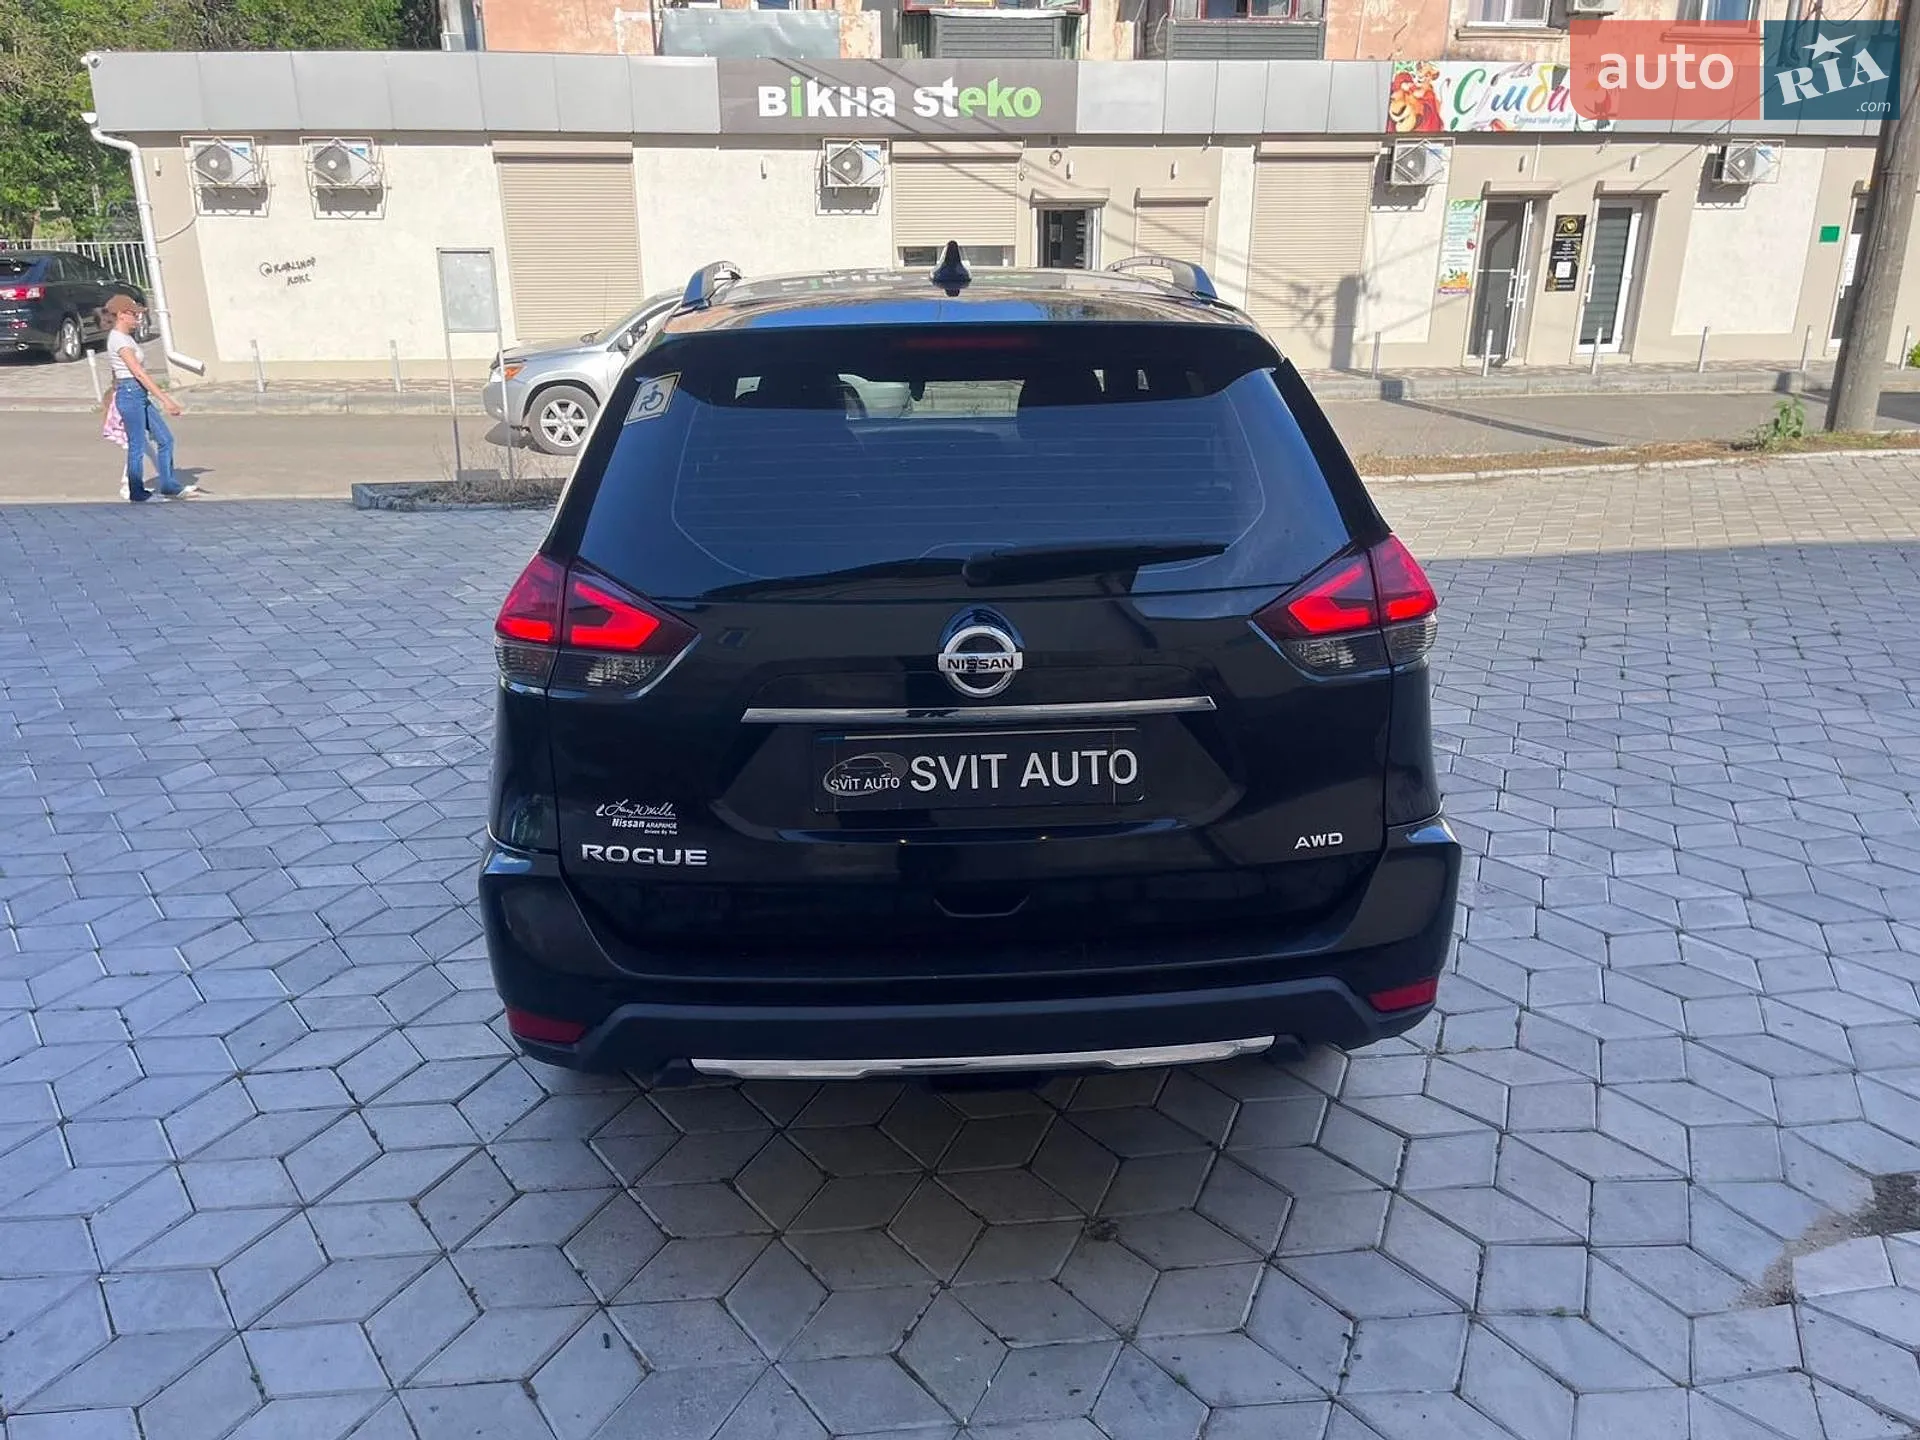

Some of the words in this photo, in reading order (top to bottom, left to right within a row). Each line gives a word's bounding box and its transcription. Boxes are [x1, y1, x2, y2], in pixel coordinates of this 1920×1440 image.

[912, 76, 1042, 118] steko
[947, 657, 1014, 671] NISSAN
[612, 818, 645, 828] Nissan
[1294, 832, 1344, 850] AWD
[581, 844, 708, 866] ROGUE
